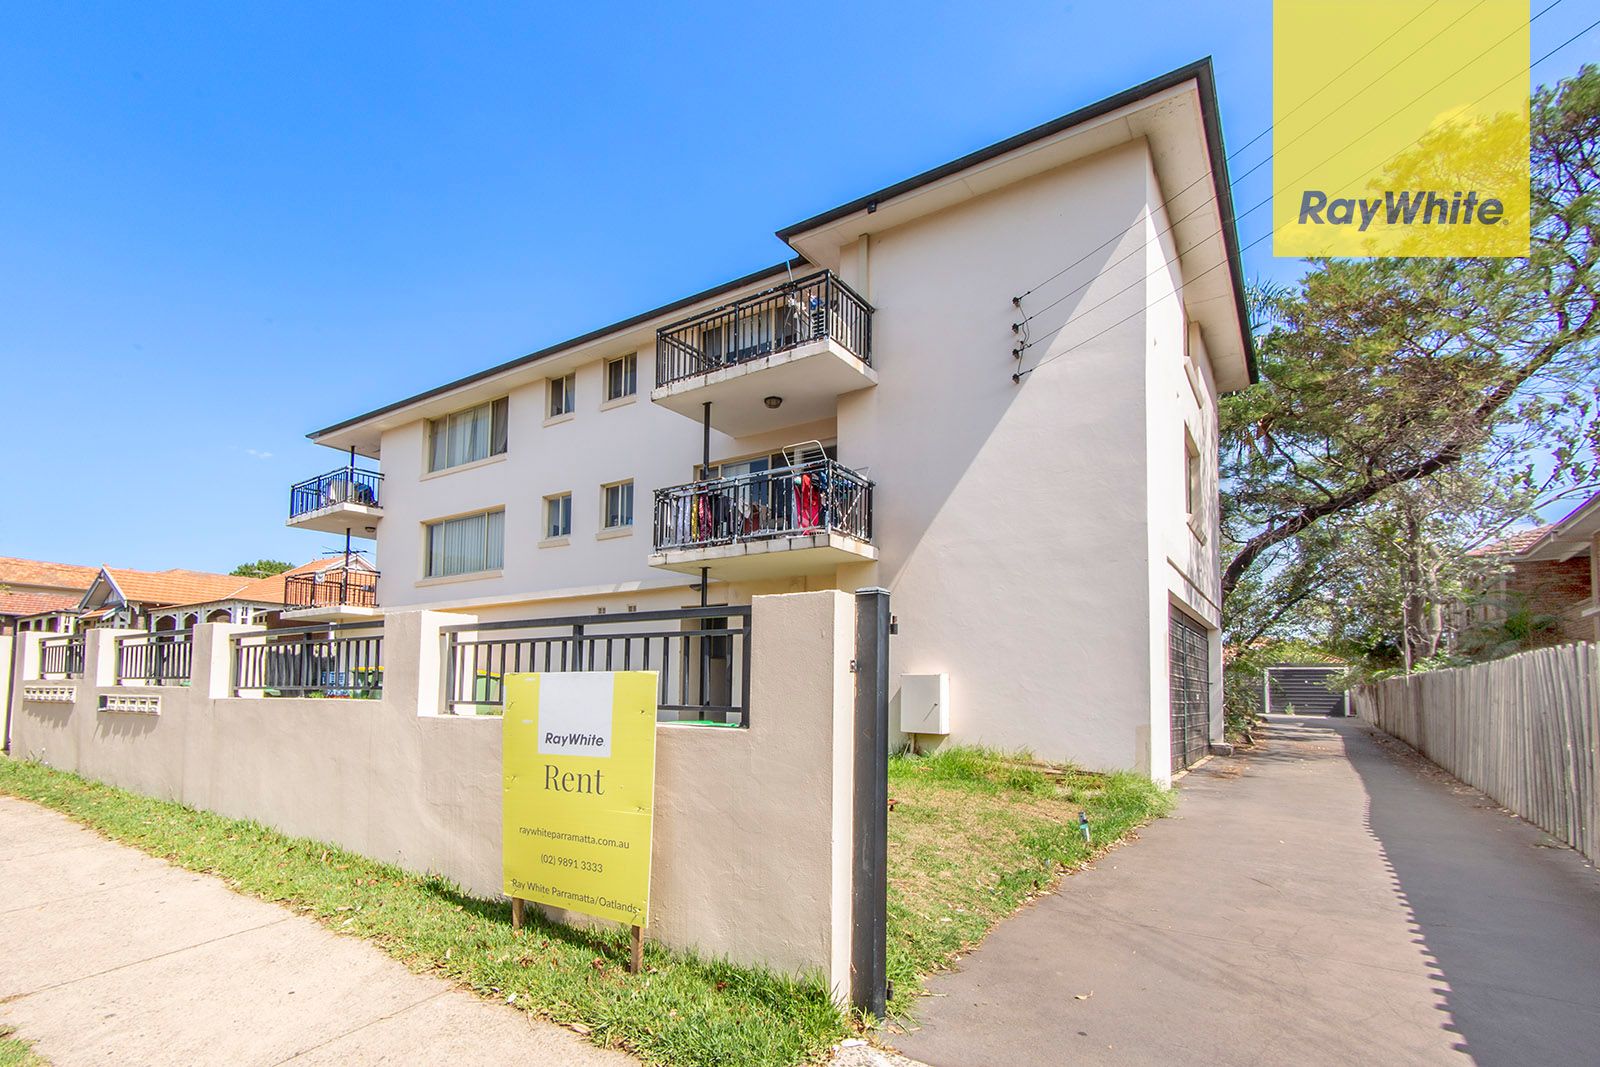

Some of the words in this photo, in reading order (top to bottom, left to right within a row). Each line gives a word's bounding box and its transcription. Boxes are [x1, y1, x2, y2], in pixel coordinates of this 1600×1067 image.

[545, 732, 604, 747] RayWhite
[544, 764, 605, 795] Rent
[519, 826, 630, 849] raywhiteparramatta.com.au
[540, 854, 556, 866] (02)
[557, 856, 578, 870] 9891
[580, 861, 603, 874] 3333
[511, 878, 526, 891] Ray
[526, 881, 550, 896] White
[551, 886, 639, 915] Parramatta/Oatlands
